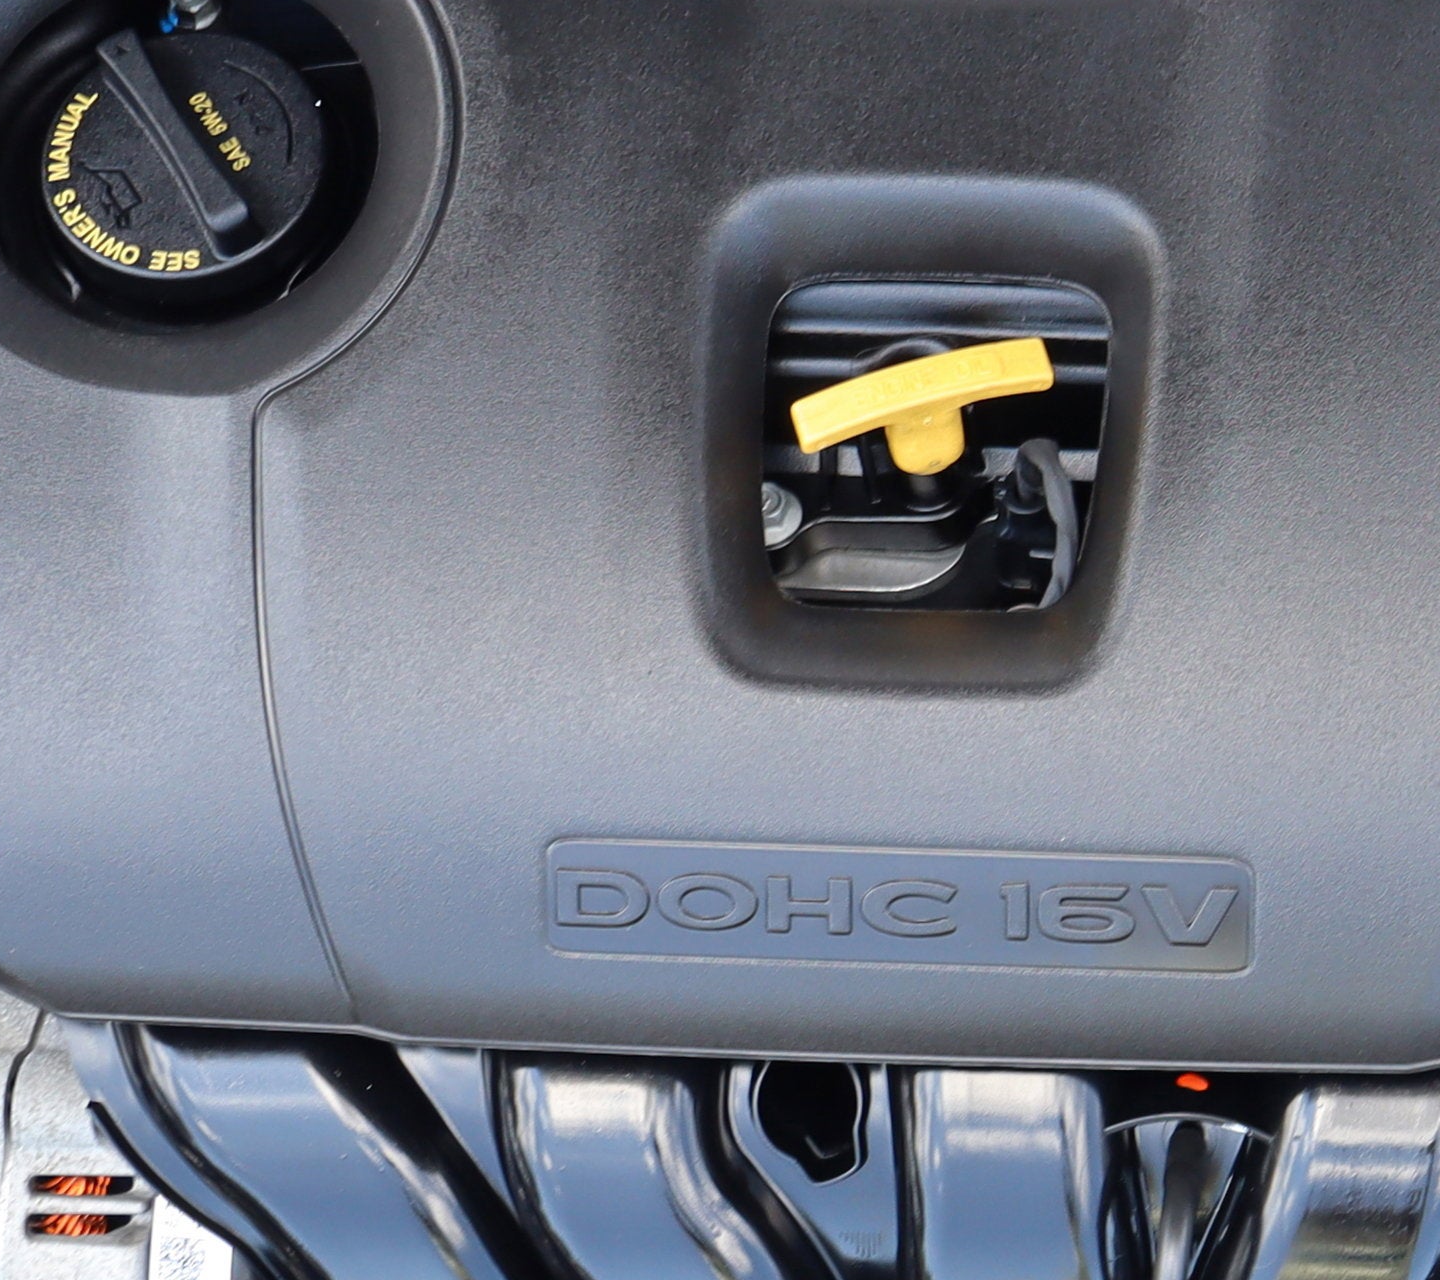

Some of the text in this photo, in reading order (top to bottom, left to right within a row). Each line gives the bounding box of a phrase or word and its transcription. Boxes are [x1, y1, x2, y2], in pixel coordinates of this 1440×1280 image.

[48, 90, 201, 272] SEE OWNER'S MANUAL
[219, 136, 252, 172] SAE
[555, 865, 1240, 947] DOHC 16V
